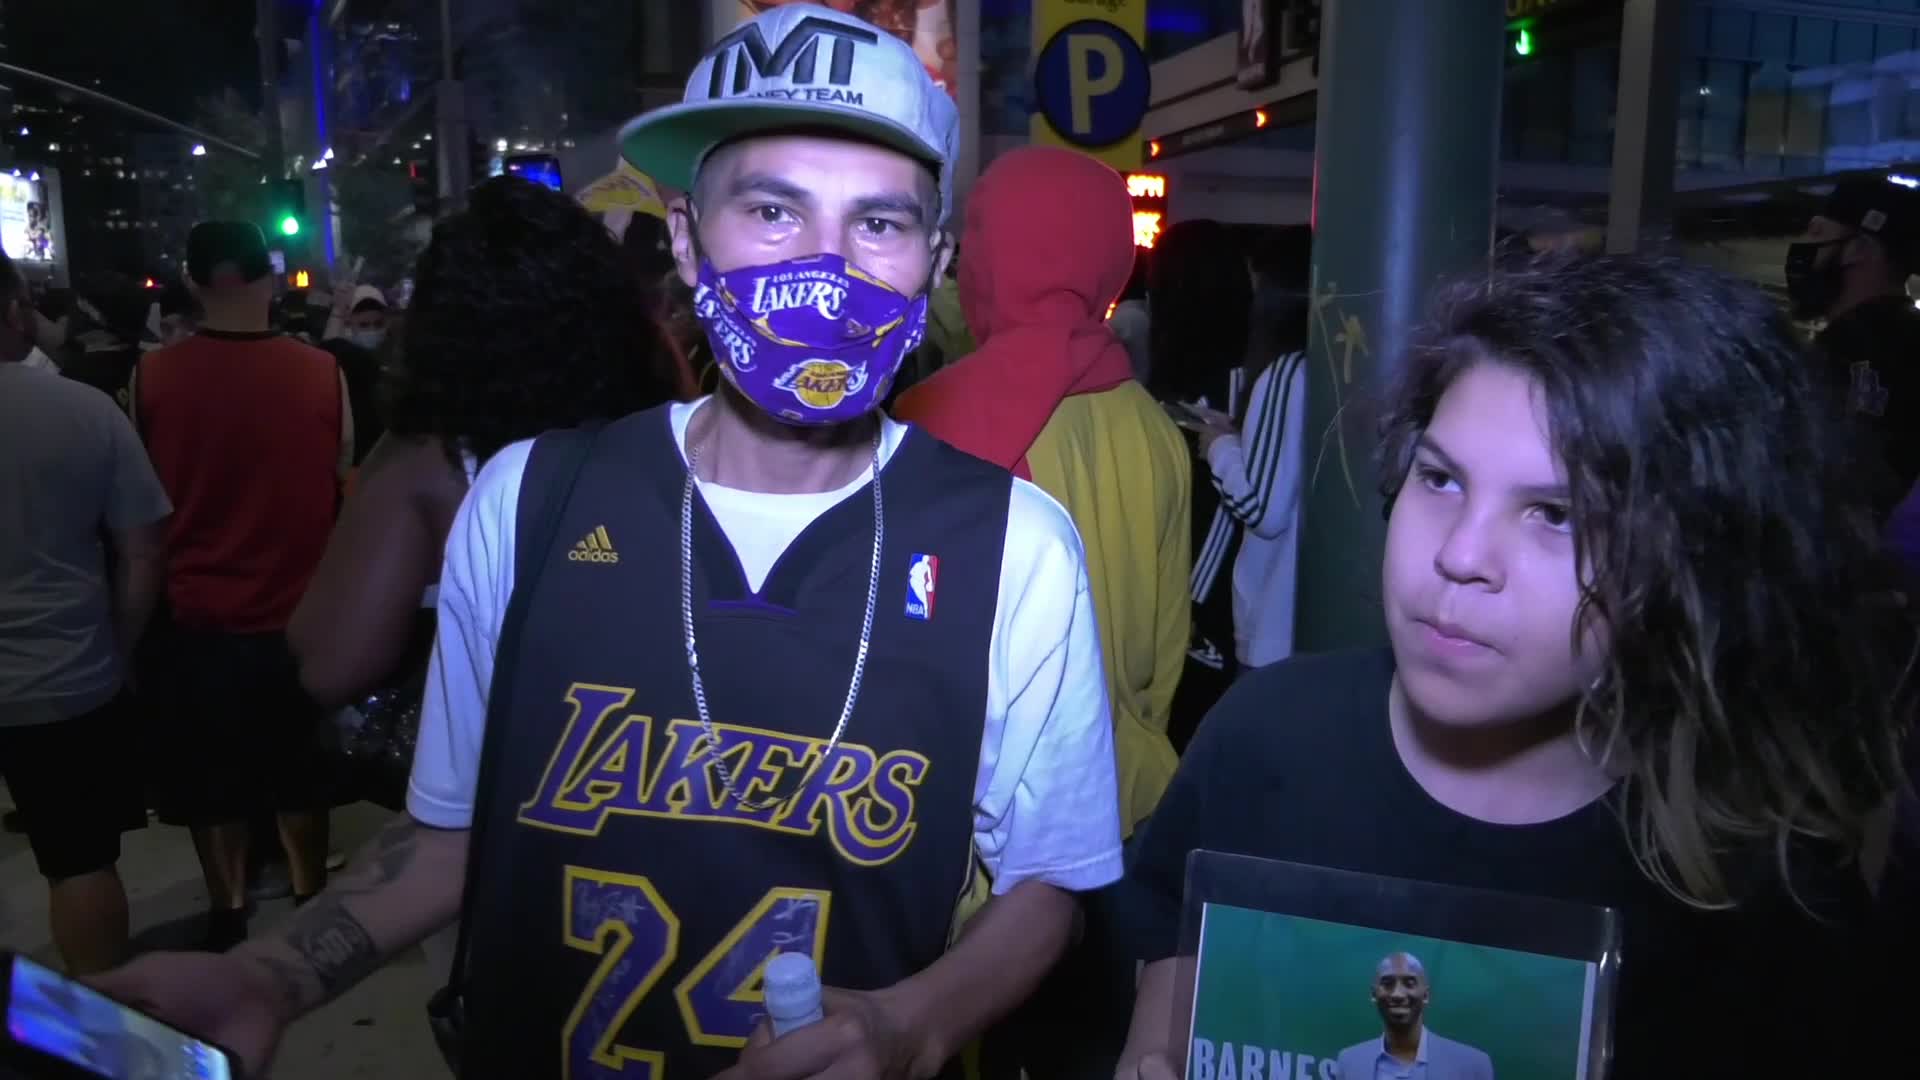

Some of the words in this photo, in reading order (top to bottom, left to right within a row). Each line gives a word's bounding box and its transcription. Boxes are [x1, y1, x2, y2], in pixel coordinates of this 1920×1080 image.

[803, 88, 864, 106] TEAM
[1067, 33, 1125, 135] P
[751, 275, 848, 321] LAKERS
[567, 548, 619, 563] adidas
[905, 602, 924, 616] NBA
[517, 682, 931, 867] LAKERS
[562, 864, 832, 1080] 24
